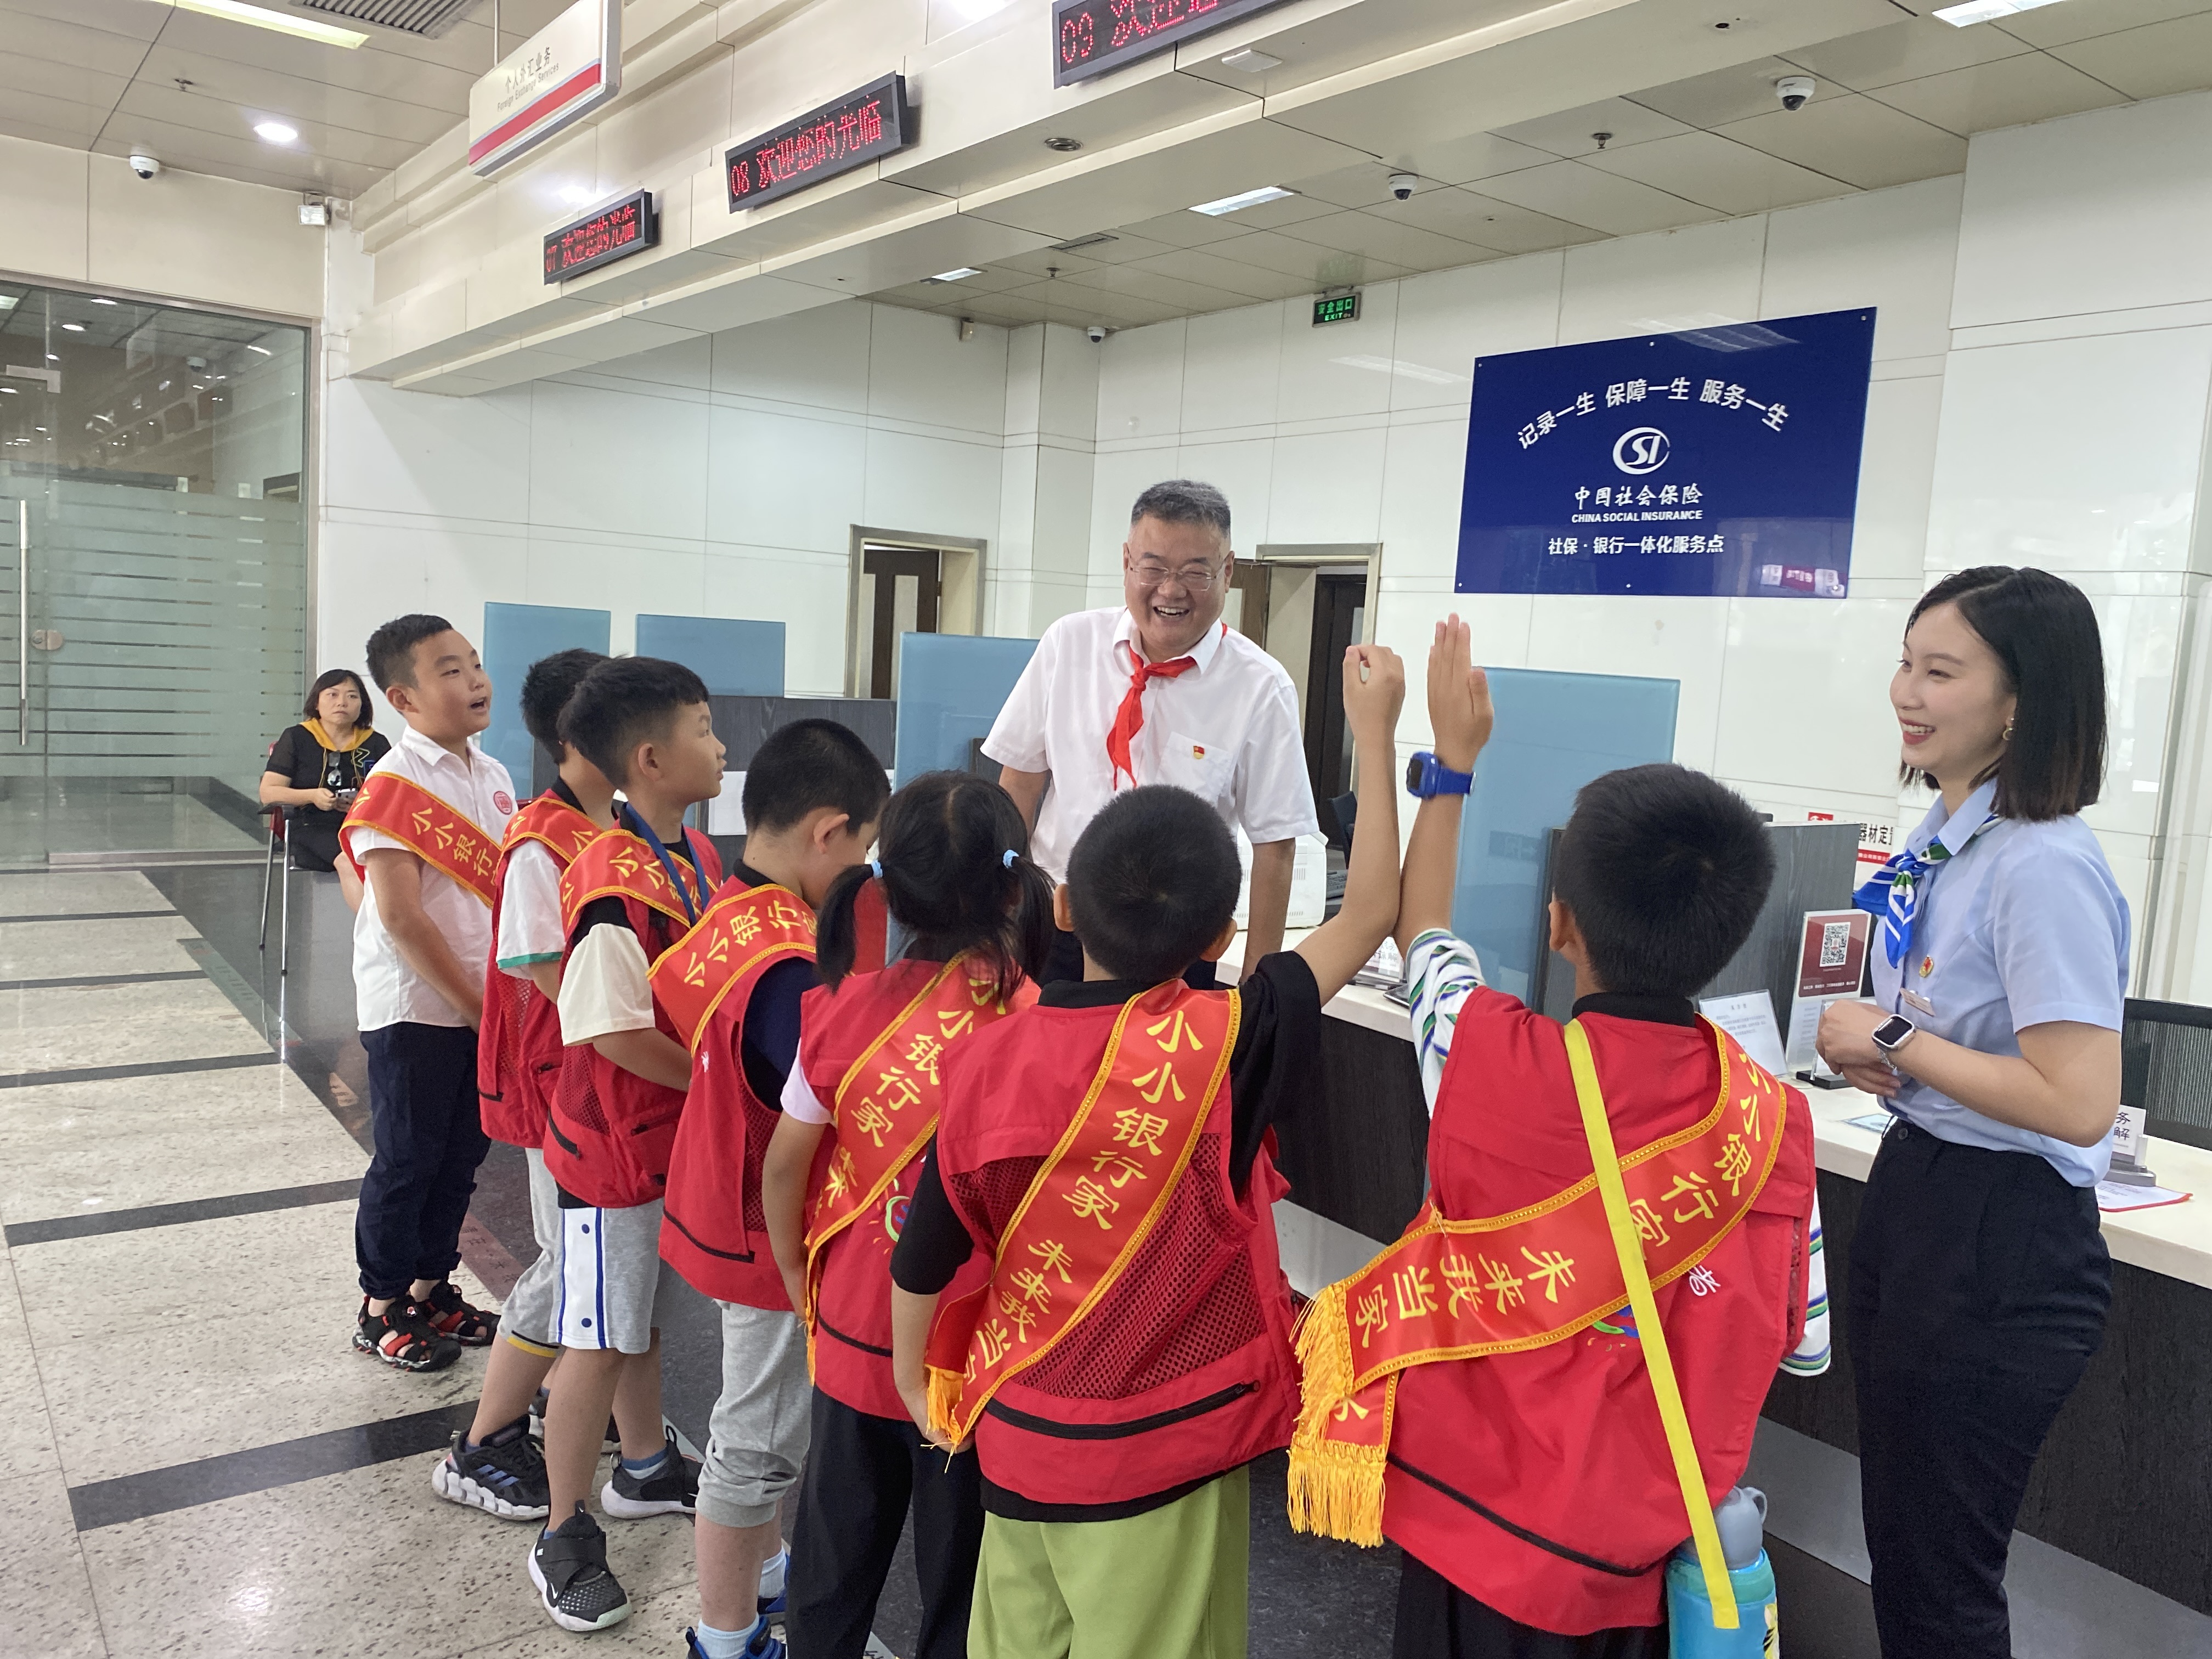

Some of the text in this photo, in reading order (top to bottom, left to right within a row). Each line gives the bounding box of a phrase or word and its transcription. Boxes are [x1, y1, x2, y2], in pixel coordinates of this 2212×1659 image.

[505, 47, 550, 94] 个人外汇业务
[1063, 12, 1093, 64] 09
[731, 95, 882, 196] 08 欢迎您的光临
[1325, 313, 1342, 321] EXIT
[1517, 377, 1788, 449] 记录一生 保障一生 服务一生
[1571, 510, 1703, 523] CHINA SOCIAL INSURANCE
[1575, 483, 1703, 510] 中国社会保险
[411, 808, 497, 886] 小小银行
[850, 978, 1006, 1147] 小小银行家
[1062, 1010, 1204, 1230] 小小银行家
[1355, 1053, 1771, 1349] 小小银行家 未来我当家
